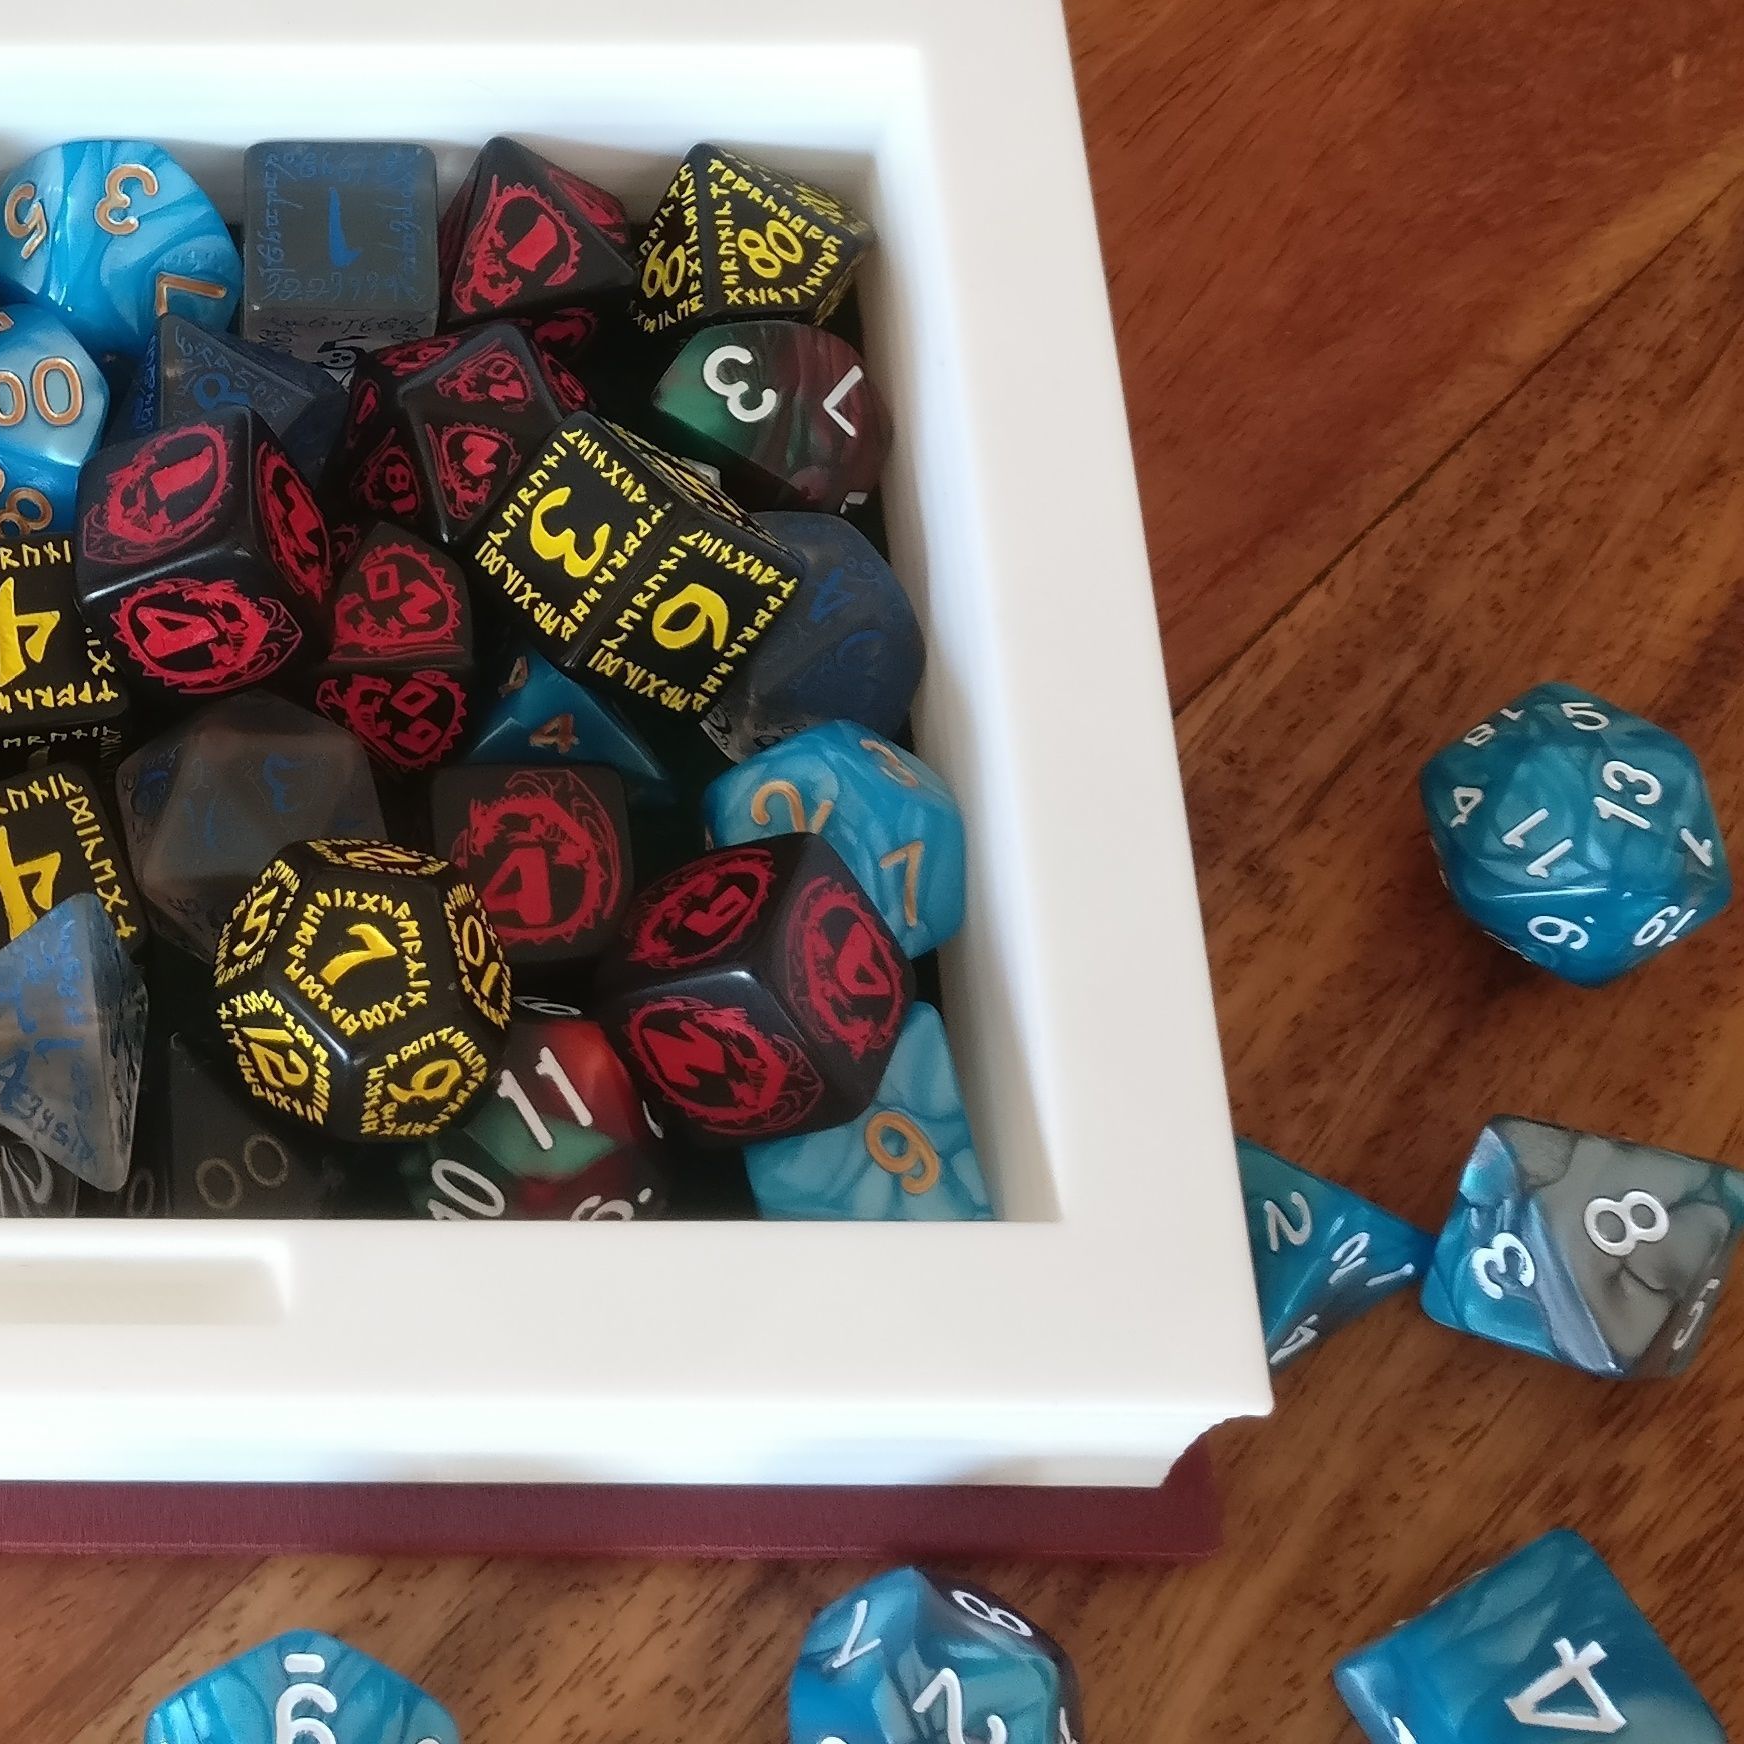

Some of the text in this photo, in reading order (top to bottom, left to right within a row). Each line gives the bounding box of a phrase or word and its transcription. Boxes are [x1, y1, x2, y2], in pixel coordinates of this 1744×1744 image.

[4, 182, 48, 260] 5
[94, 162, 159, 236] 3
[737, 219, 804, 279] 80
[702, 344, 778, 424] 3
[529, 486, 611, 579] 3
[134, 605, 219, 660] 4
[528, 712, 580, 754] 4
[1463, 706, 1525, 747] 18
[1560, 701, 1610, 732] 5
[750, 779, 834, 833] 2
[1449, 786, 1485, 828] 4
[1593, 760, 1663, 830] 13
[1501, 807, 1574, 879] 11
[1679, 827, 1714, 867] 1
[481, 846, 553, 926] 4
[231, 885, 280, 958] 5
[1632, 905, 1698, 947] 19
[461, 914, 502, 998] 10
[241, 1026, 310, 1089] 12
[497, 1045, 594, 1150] 11
[1263, 1190, 1313, 1253] 2
[1583, 1190, 1670, 1257] 8
[1471, 1231, 1536, 1301] 3
[950, 1589, 1033, 1638] 8
[1503, 1636, 1628, 1735] 4
